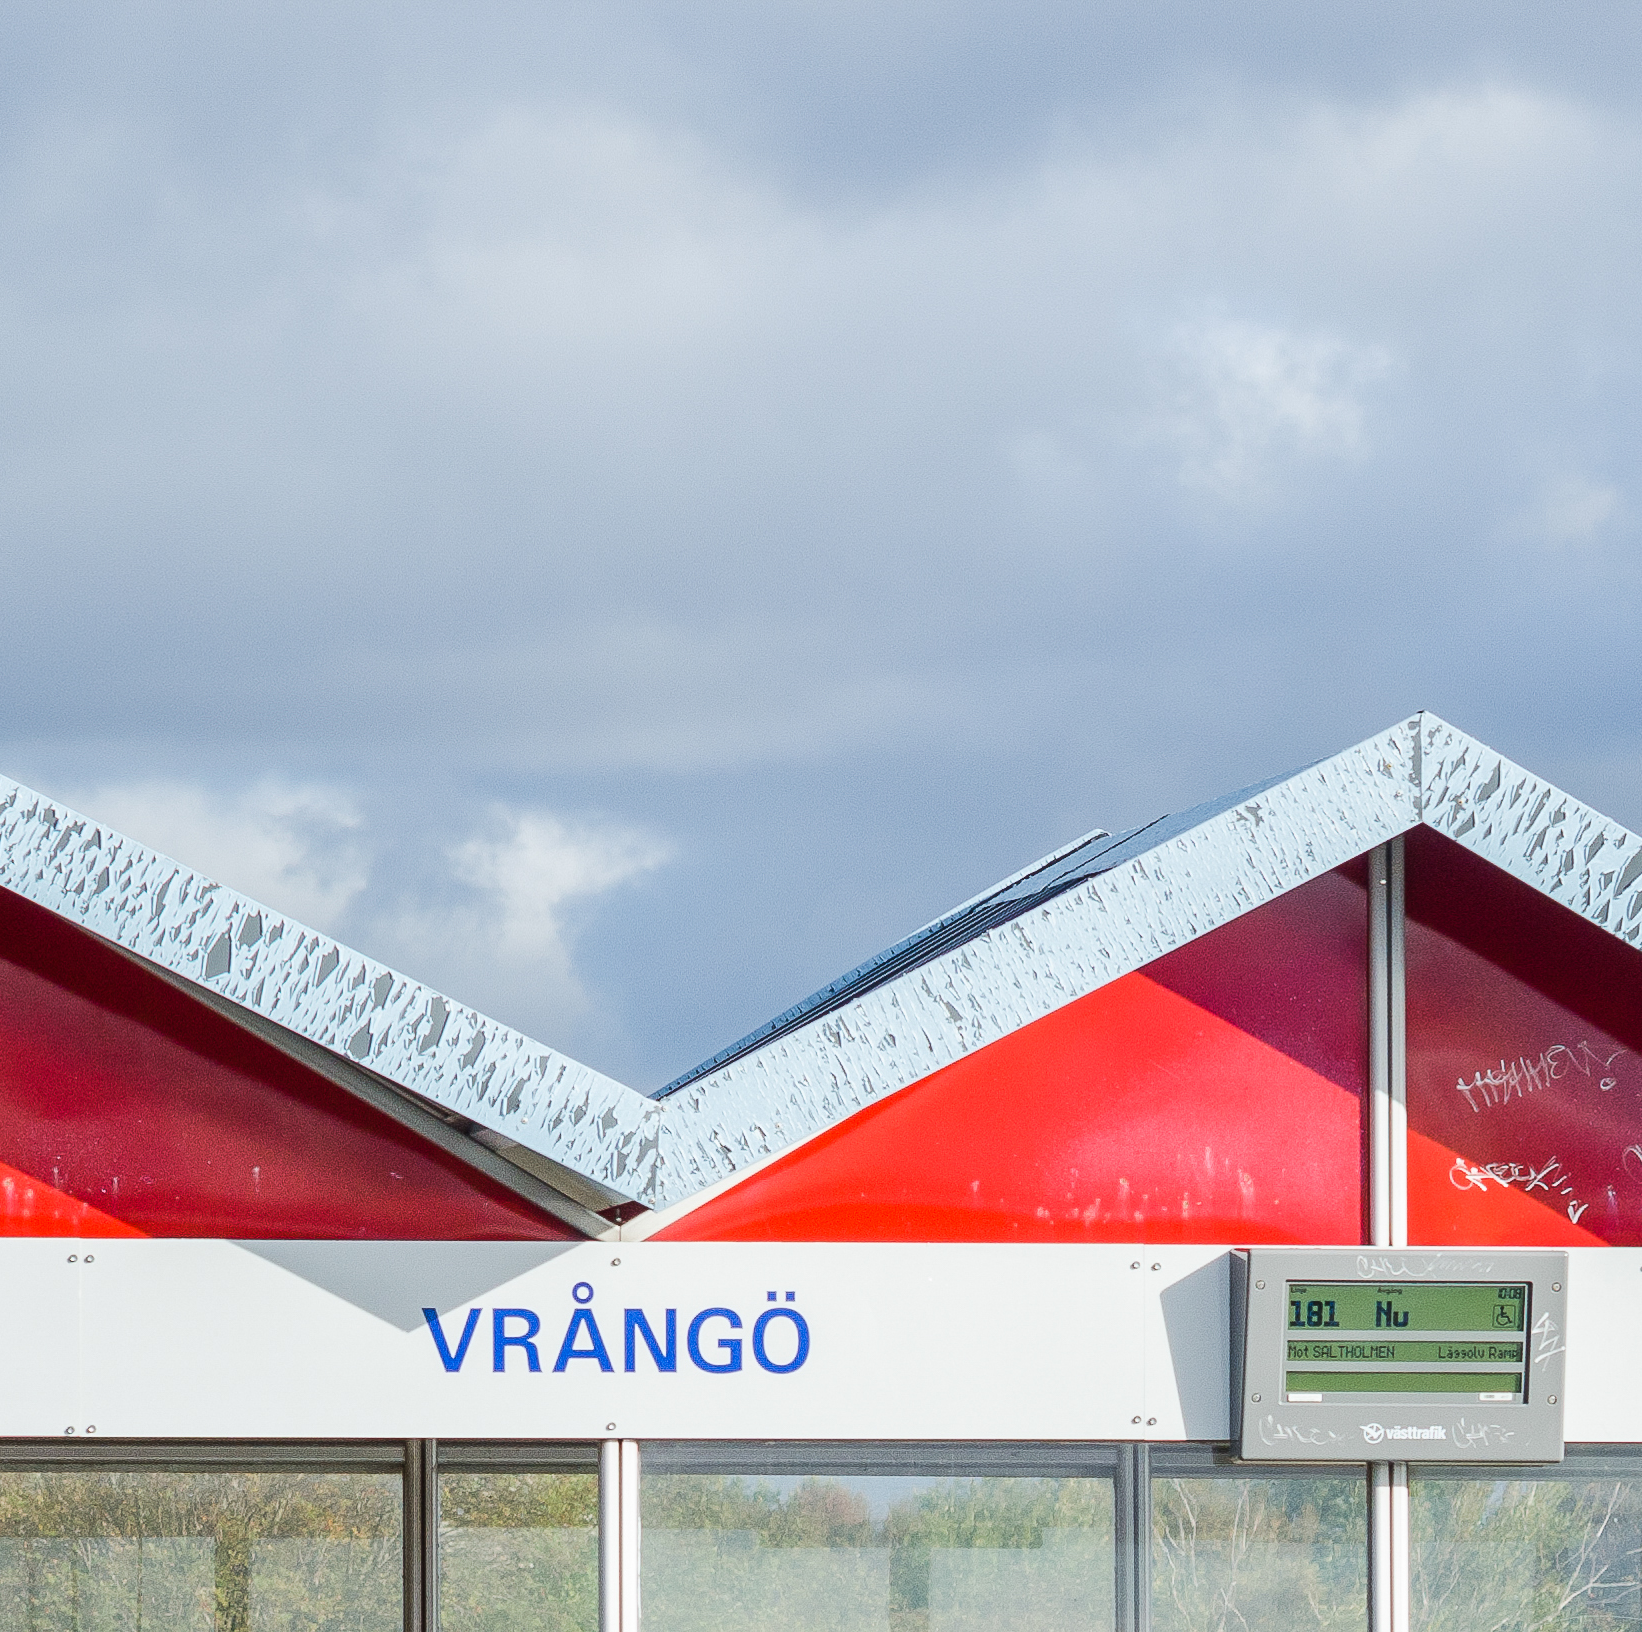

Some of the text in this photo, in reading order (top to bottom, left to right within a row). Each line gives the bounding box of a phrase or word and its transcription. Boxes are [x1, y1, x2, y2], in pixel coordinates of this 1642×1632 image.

[1289, 1300, 1409, 1328] 181 Nu
[422, 1281, 811, 1374] VRÅNGÖ
[1288, 1346, 1308, 1359] Mot
[1313, 1345, 1395, 1359] SALTHOLMEN
[1386, 1424, 1447, 1441] västtrafik
